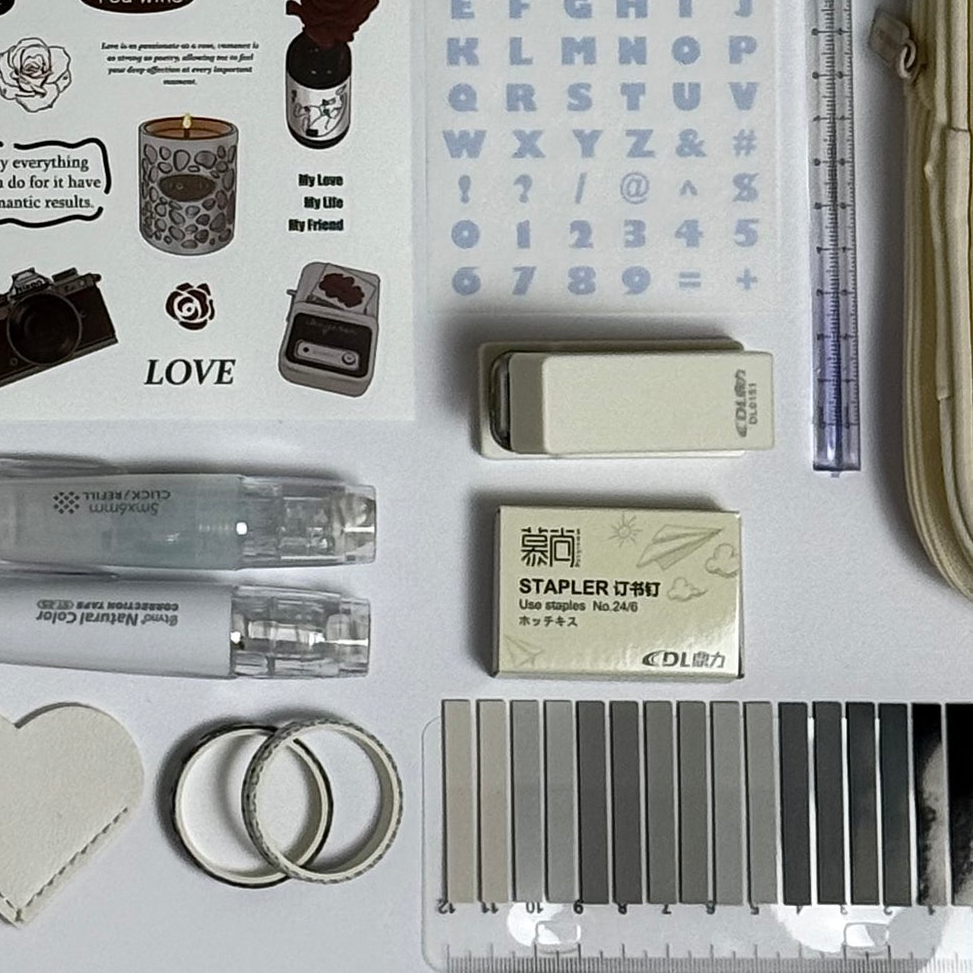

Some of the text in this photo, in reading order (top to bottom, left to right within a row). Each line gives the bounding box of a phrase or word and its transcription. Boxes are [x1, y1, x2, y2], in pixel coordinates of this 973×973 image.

[12, 154, 89, 173] everything
[7, 175, 26, 190] do
[28, 175, 50, 190] for
[53, 175, 64, 190] it
[67, 174, 102, 189] have
[298, 173, 343, 187] My Love
[45, 195, 95, 209] results.
[304, 196, 344, 210] My Life
[288, 218, 344, 232] My Friend
[568, 220, 592, 249] 2
[624, 220, 646, 249] 3
[675, 219, 703, 248] 4
[734, 218, 760, 248] 5
[144, 359, 236, 385] LOVE
[520, 526, 575, 568] 慕尚
[519, 578, 609, 595] STAPLER
[613, 581, 661, 597] 订书钉
[107, 601, 179, 612] CORRECTION
[519, 599, 638, 612] Use staples No.24/6
[36, 611, 77, 624] Color
[80, 612, 139, 626] Natural
[518, 615, 578, 627] ホッチキス
